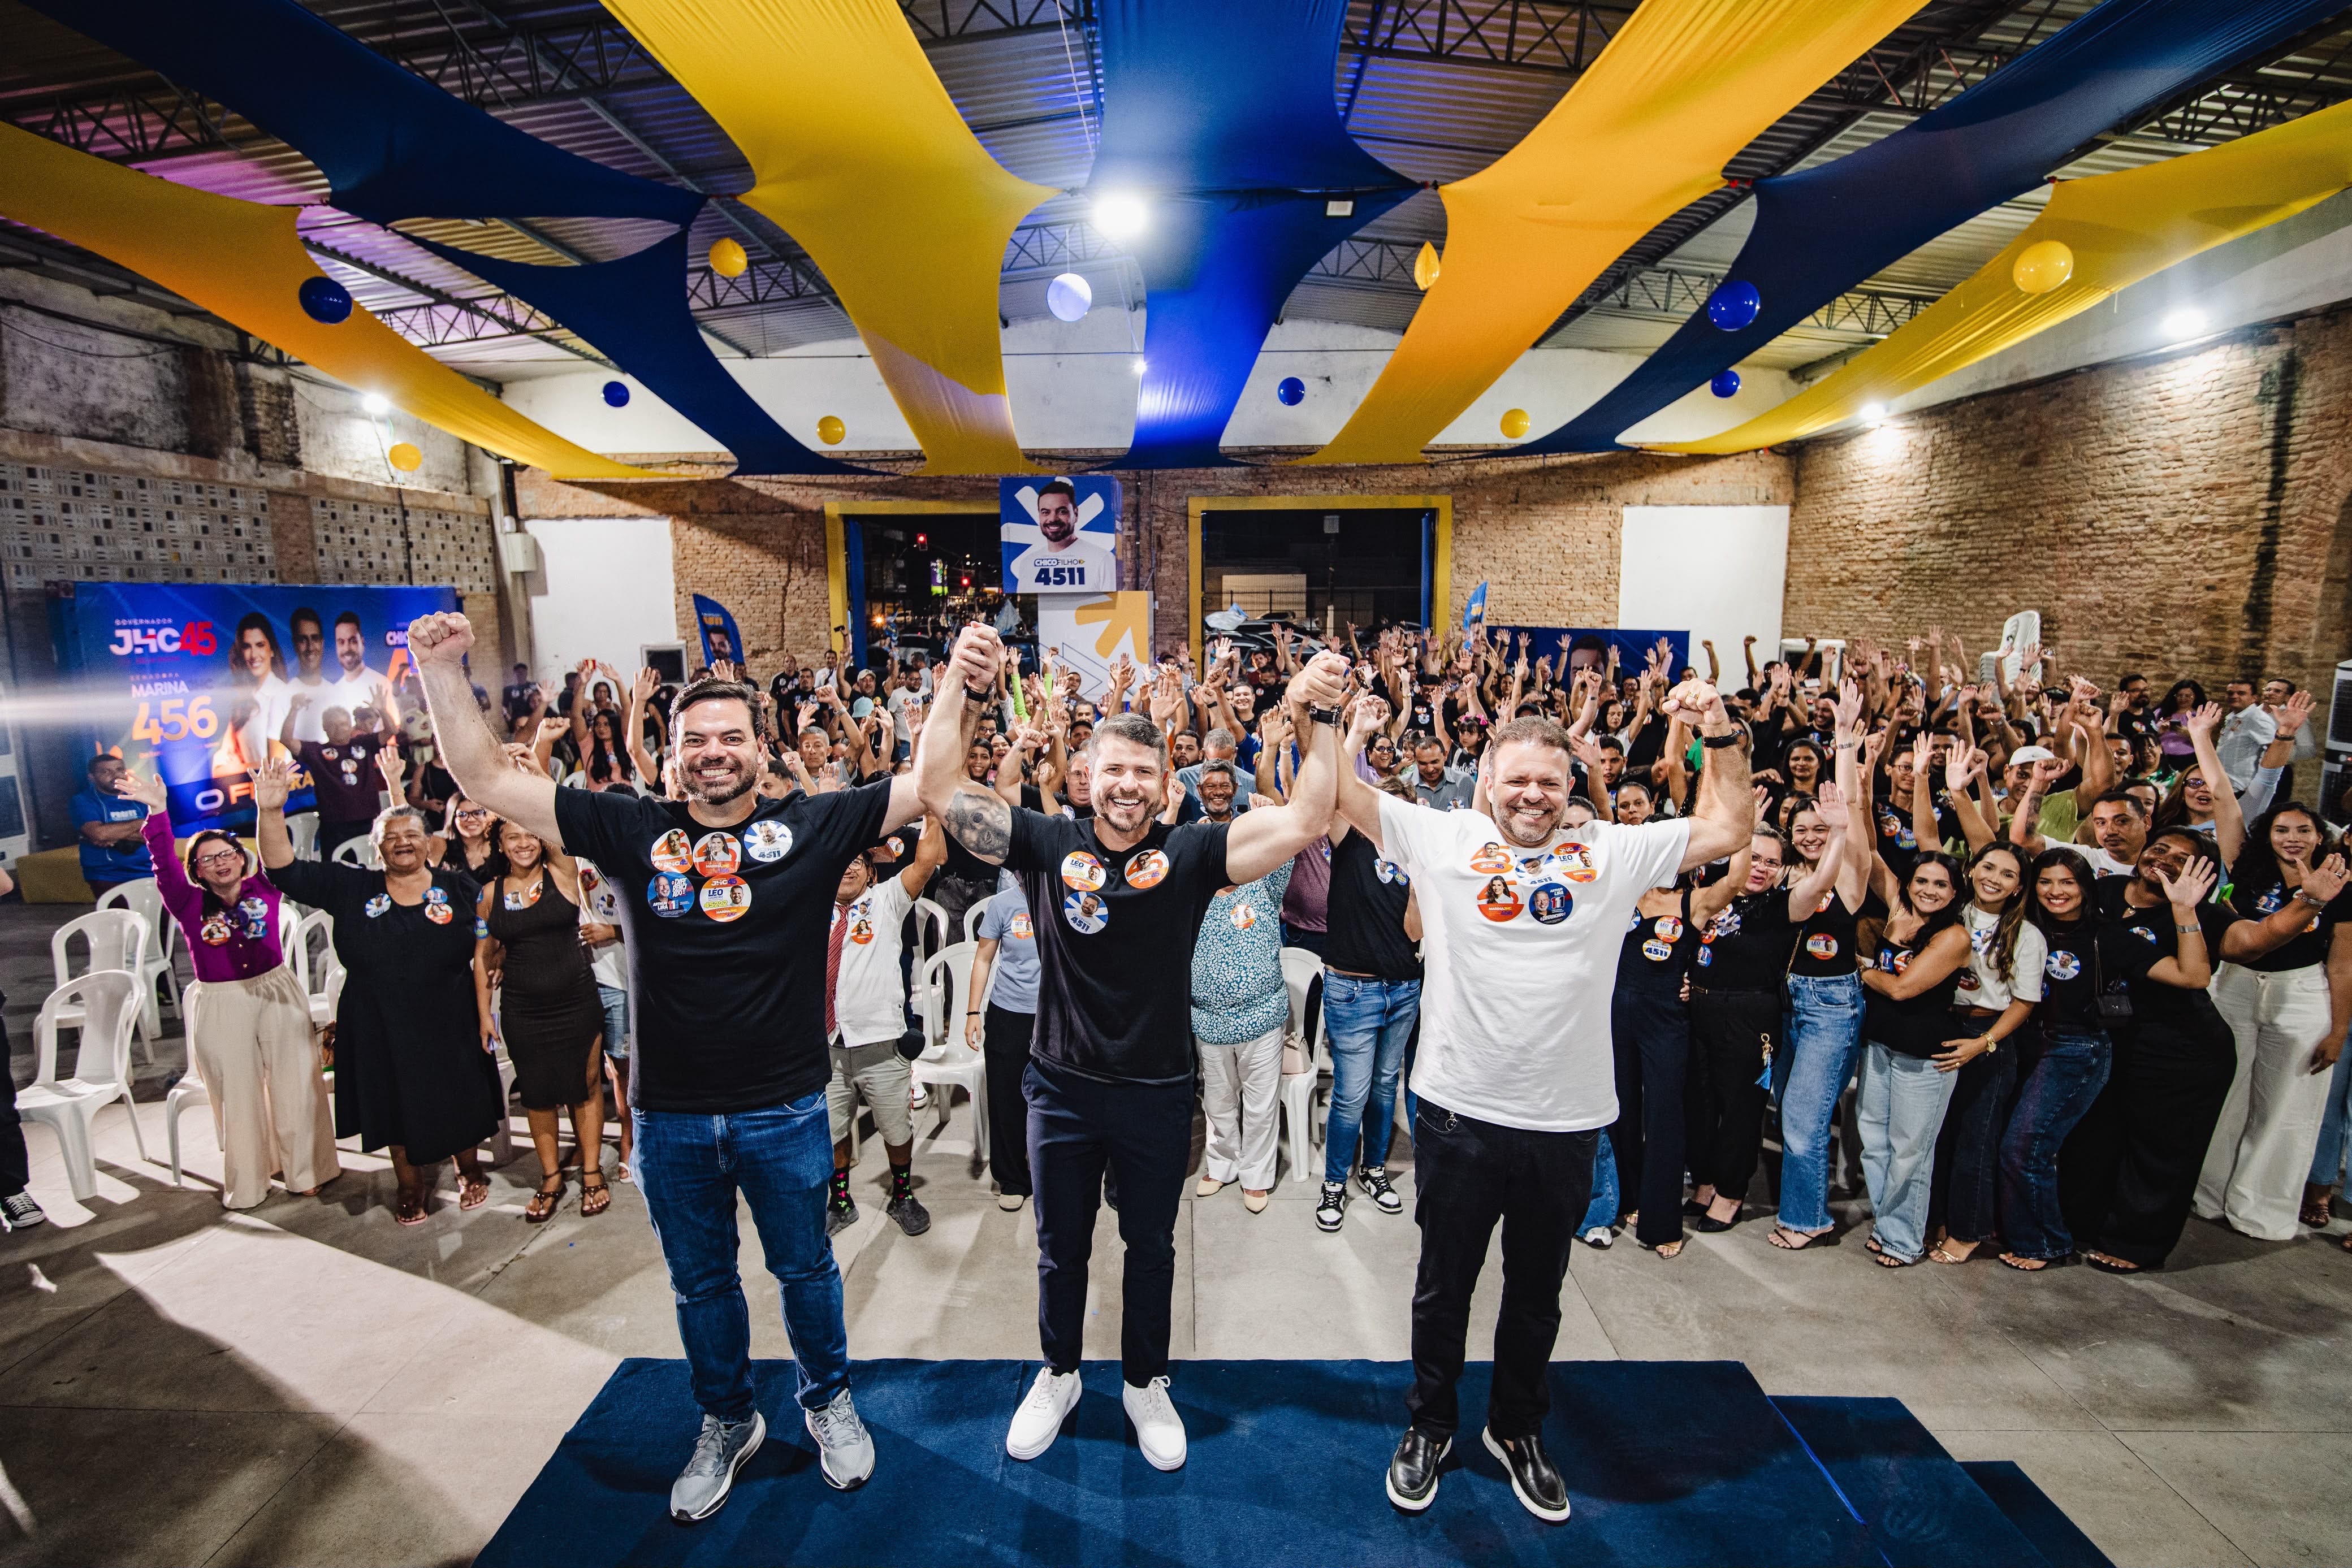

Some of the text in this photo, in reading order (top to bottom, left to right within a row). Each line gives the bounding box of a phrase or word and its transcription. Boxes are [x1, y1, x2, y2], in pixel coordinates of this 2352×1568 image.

[1035, 568, 1085, 585] 4511
[131, 680, 189, 698] MARINA
[131, 696, 218, 745] 456
[704, 900, 728, 908] 45222
[1071, 916, 1090, 932] 4511
[1645, 947, 1668, 957] 4511
